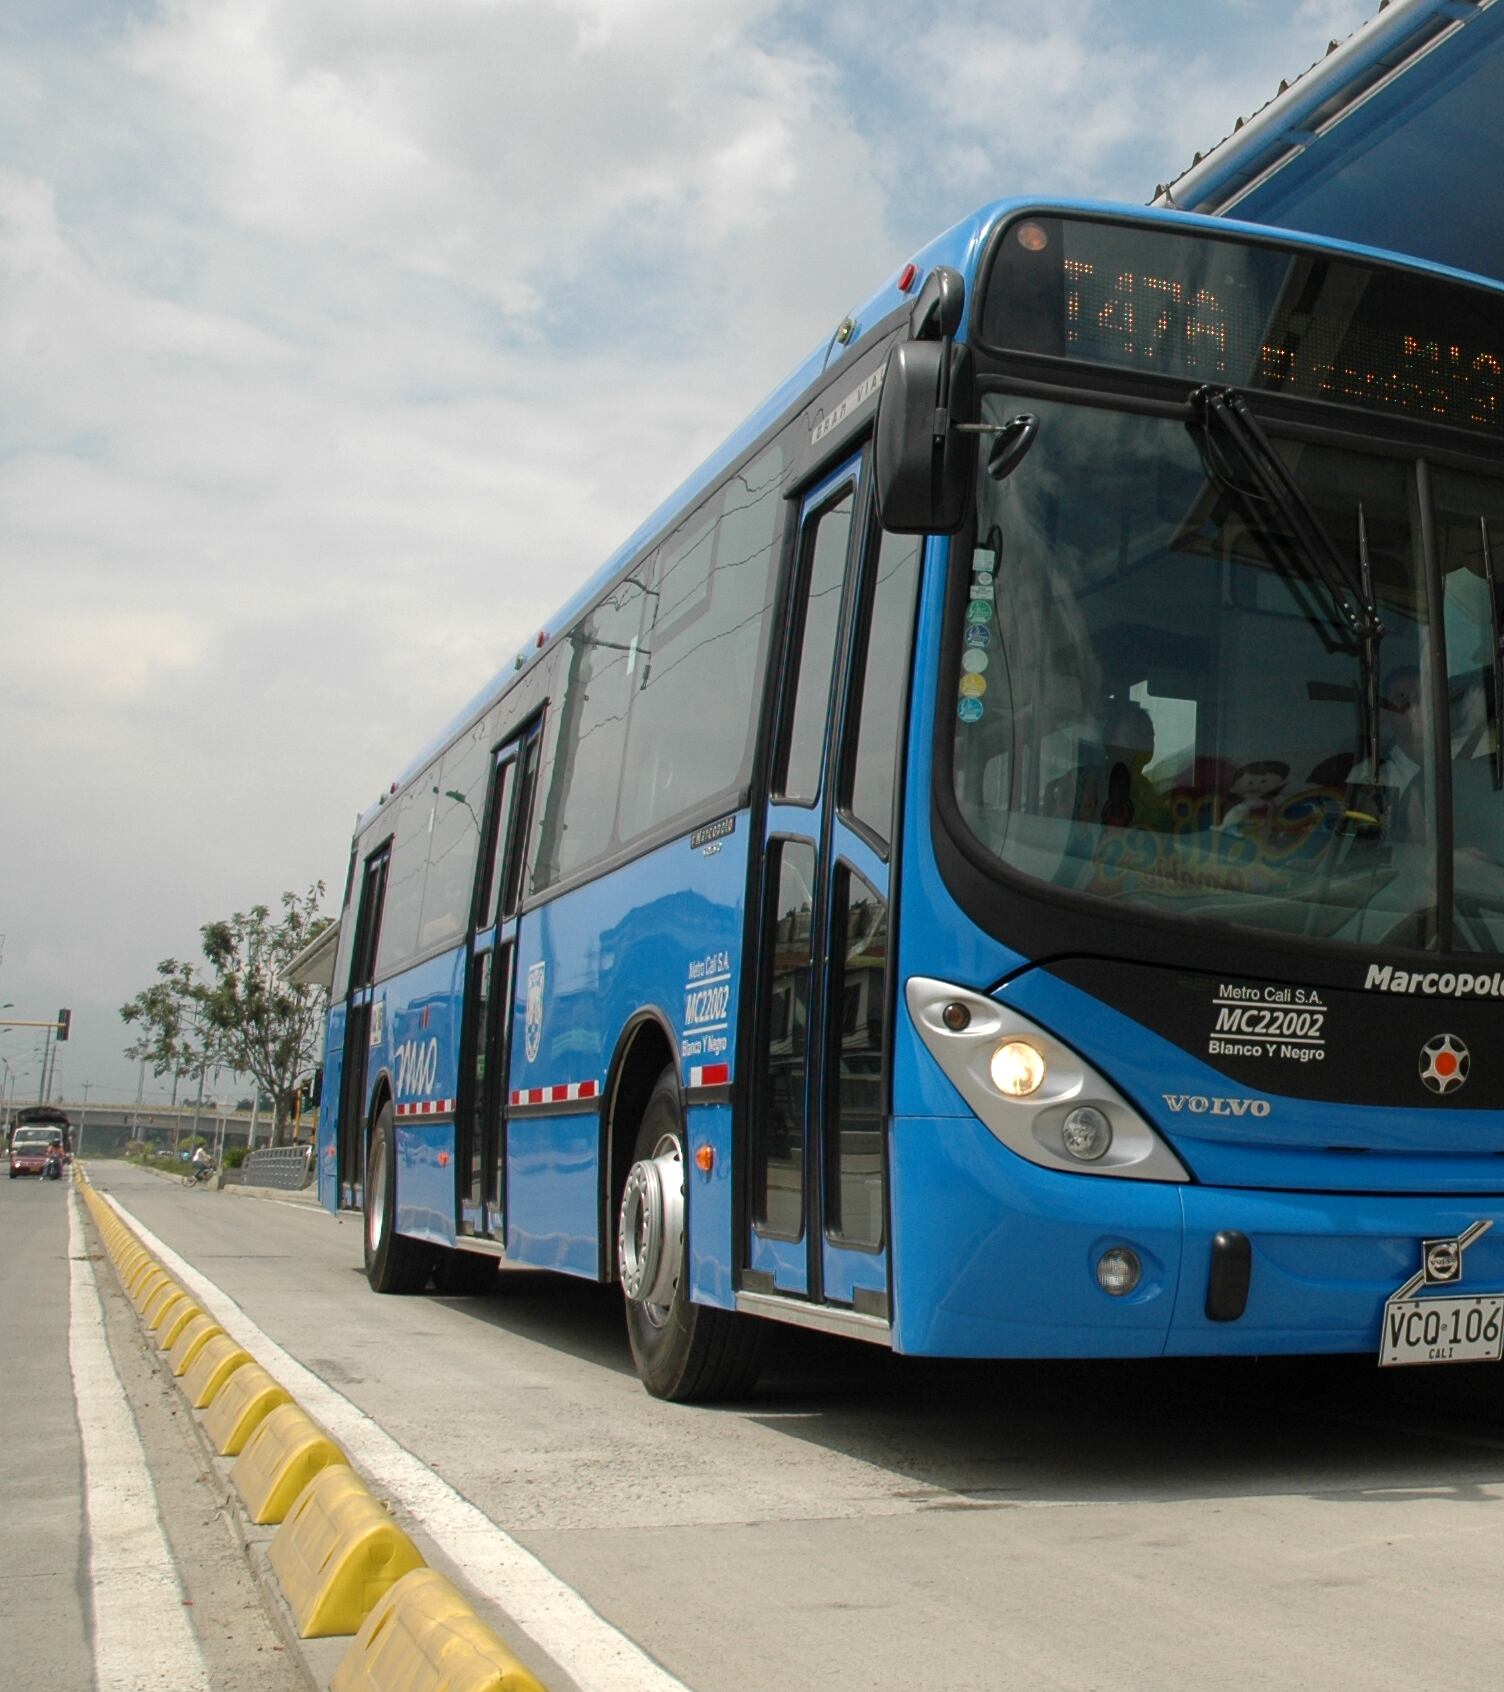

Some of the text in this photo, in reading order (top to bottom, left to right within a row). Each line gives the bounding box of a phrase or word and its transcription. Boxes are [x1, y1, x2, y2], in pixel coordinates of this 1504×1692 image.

[1063, 258, 1228, 371] T47A
[685, 985, 729, 1025] MC22002
[1219, 983, 1323, 1004] Metro Cali S.A.
[1214, 1007, 1324, 1038] MC22002
[1208, 1040, 1325, 1062] Blanco Y Negro
[1162, 1093, 1272, 1118] VOLVO
[1428, 1347, 1454, 1360] CALI
